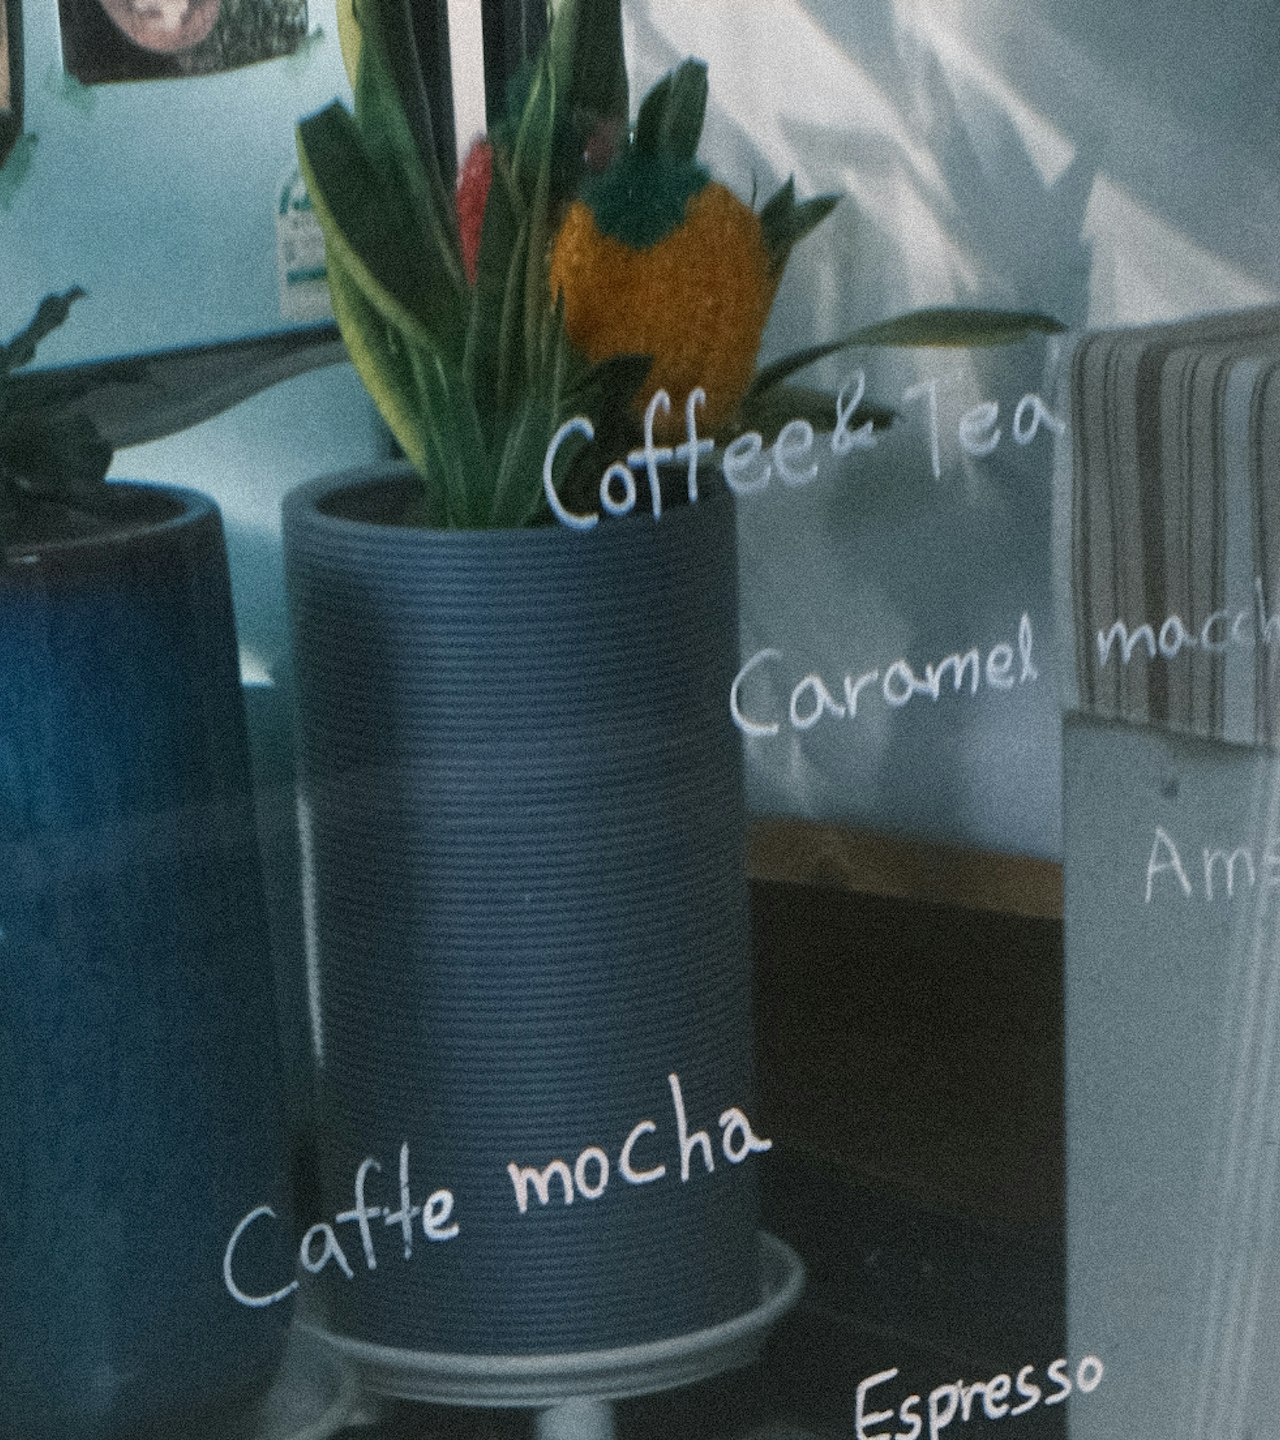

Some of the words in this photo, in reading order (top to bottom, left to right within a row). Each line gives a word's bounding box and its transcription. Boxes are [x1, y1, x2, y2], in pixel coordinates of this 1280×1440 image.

[900, 380, 1066, 482] Tea
[730, 611, 1039, 738] Caramel
[506, 1072, 773, 1214] mocha
